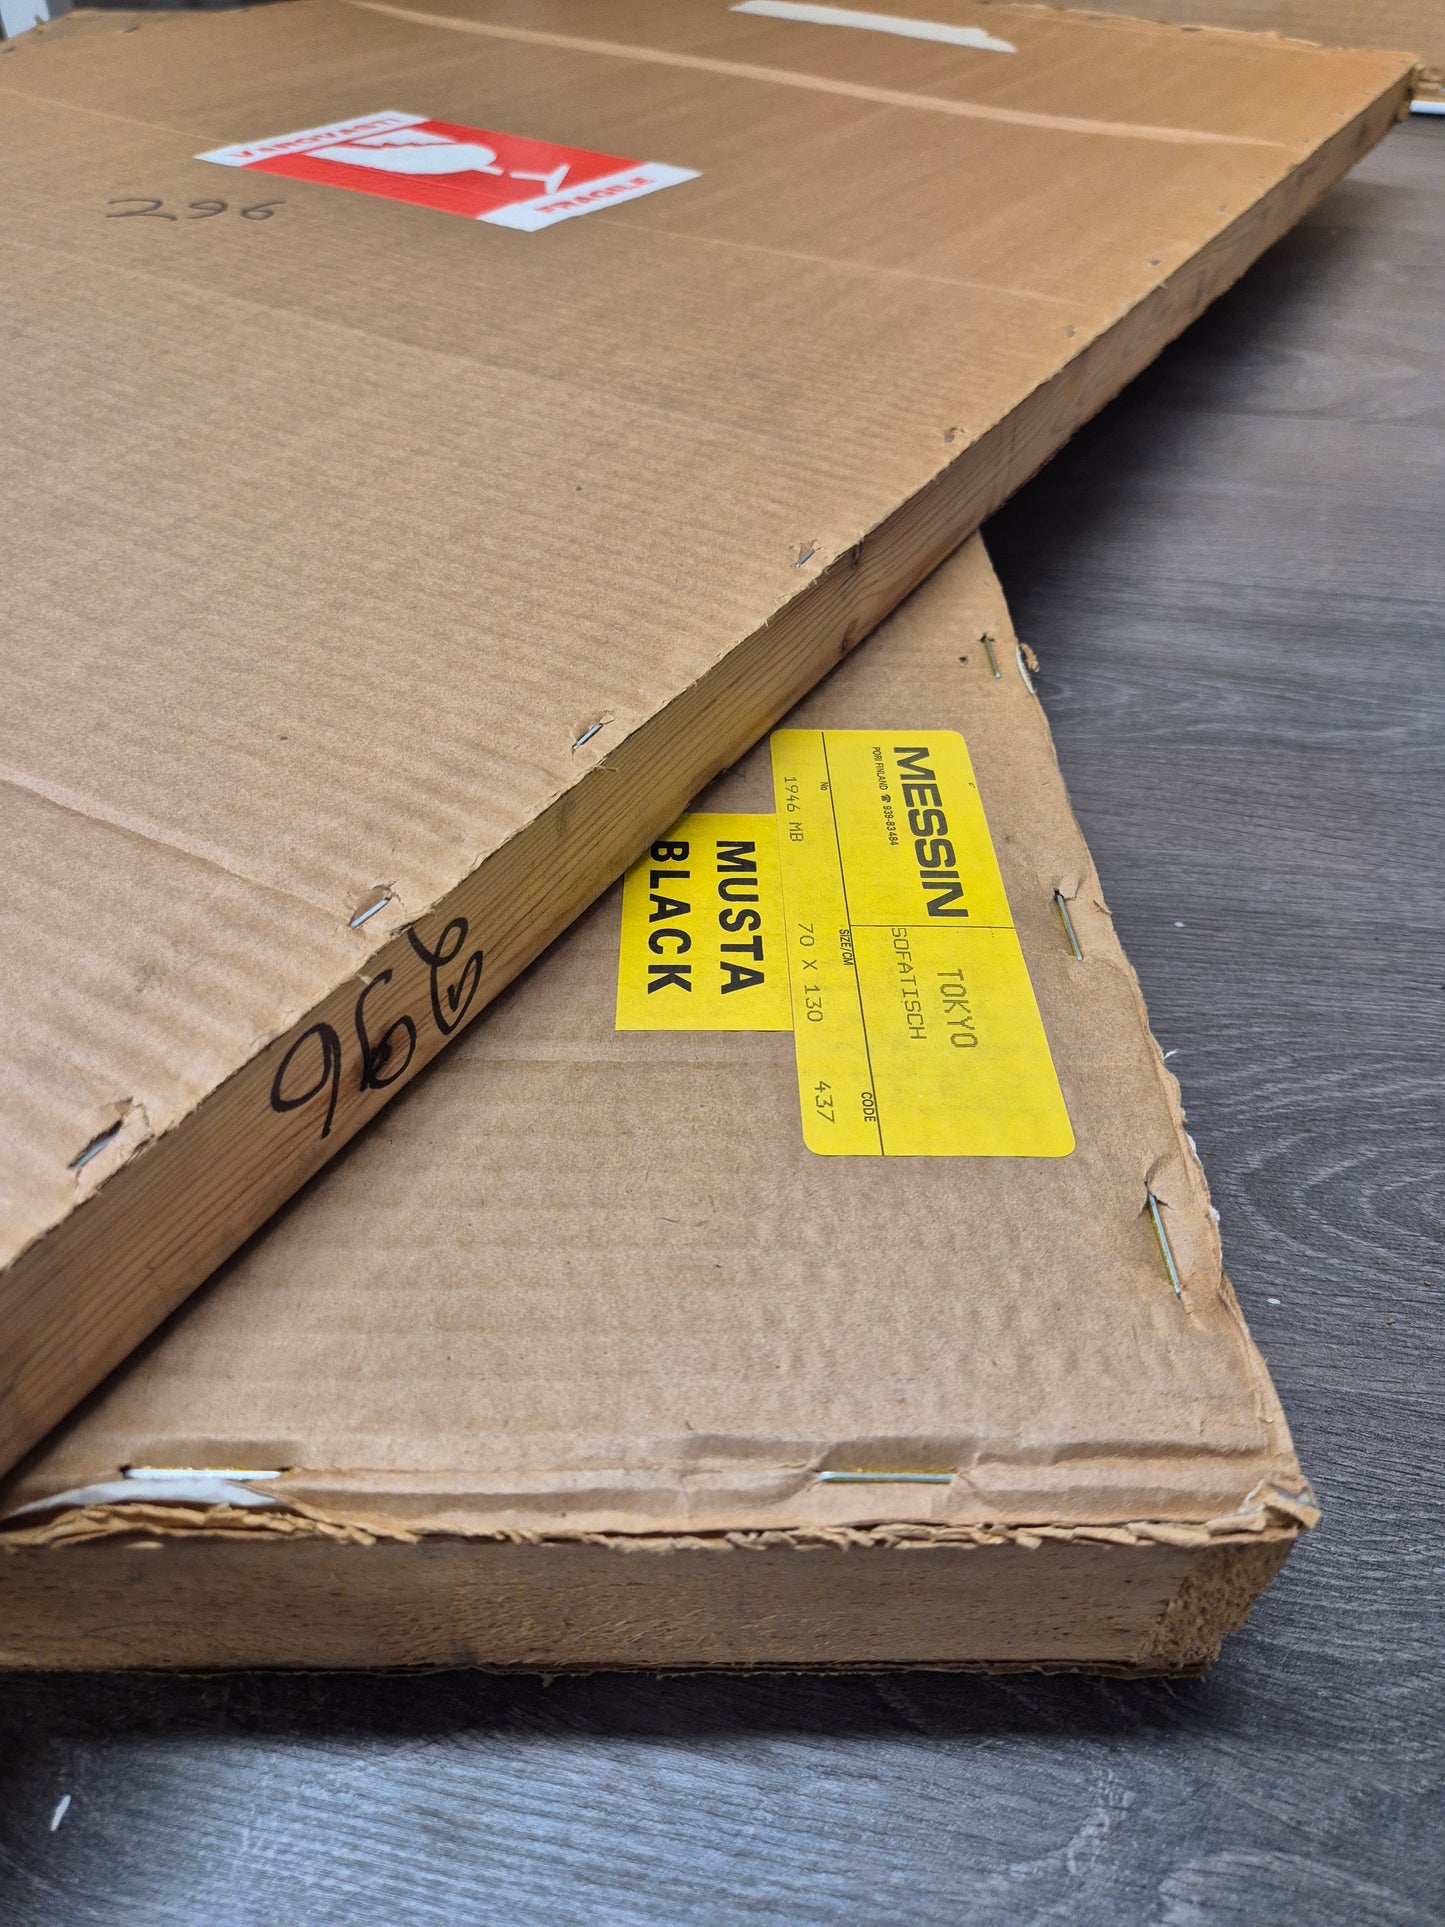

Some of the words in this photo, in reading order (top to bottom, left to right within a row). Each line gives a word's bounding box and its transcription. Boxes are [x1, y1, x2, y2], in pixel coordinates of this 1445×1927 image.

[105, 198, 288, 221] 296
[532, 176, 657, 214] FRAGILE
[872, 746, 882, 761] PORI
[877, 763, 888, 791] FINLAND
[784, 776, 801, 813] 1946
[788, 822, 804, 842] MB
[893, 746, 969, 918] MESSIN
[648, 840, 692, 995] BLACK
[716, 840, 765, 995] MUSTA
[798, 923, 815, 947] 70
[839, 928, 855, 966] SIZE/CM
[892, 927, 927, 1040] SOFATISCH
[804, 984, 824, 1023] 130
[937, 968, 978, 1048] TOKYO
[814, 1080, 835, 1123] 437
[861, 1091, 877, 1123] CODE
